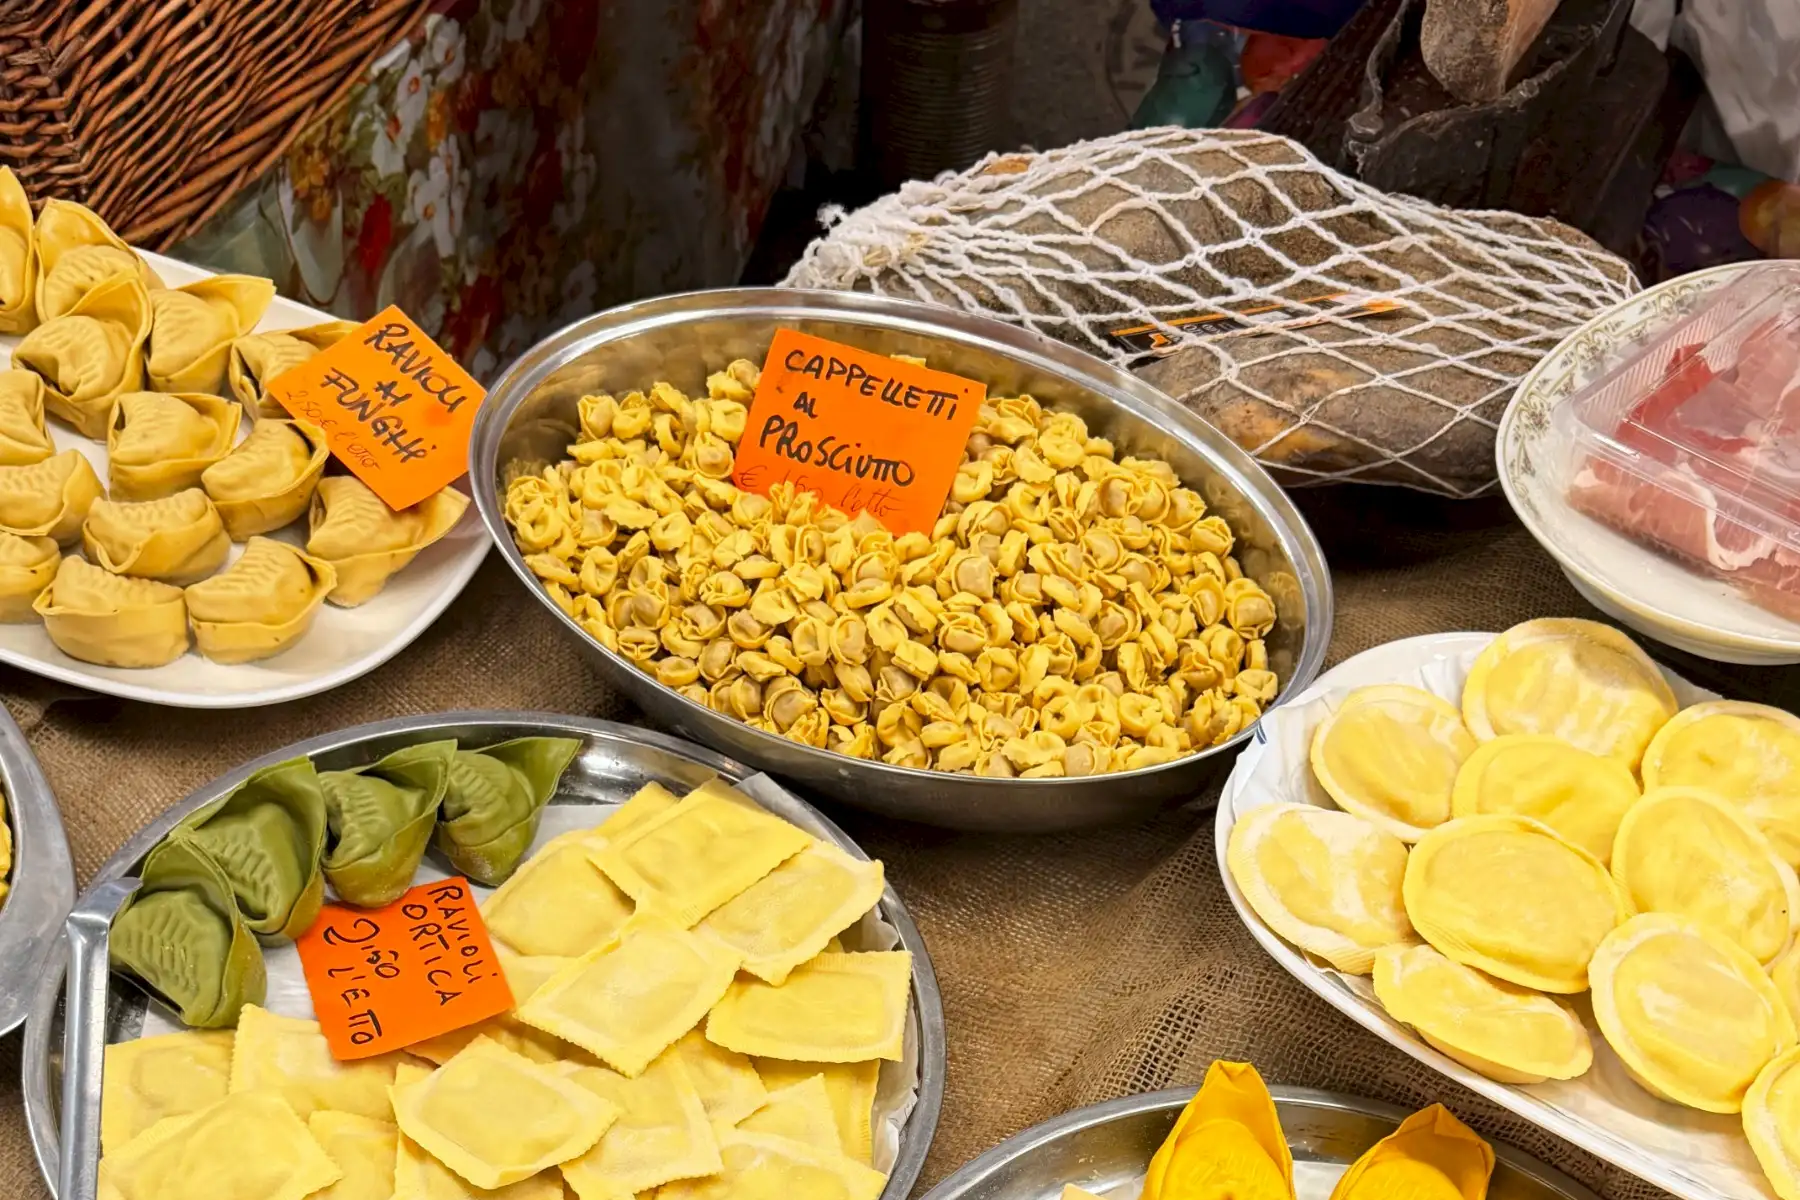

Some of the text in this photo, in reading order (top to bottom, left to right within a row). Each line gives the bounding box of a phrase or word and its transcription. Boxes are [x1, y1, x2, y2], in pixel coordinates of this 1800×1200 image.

[785, 349, 969, 421] CAPPELLETTI
[792, 391, 818, 419] AL
[401, 903, 462, 1007] ORTICA
